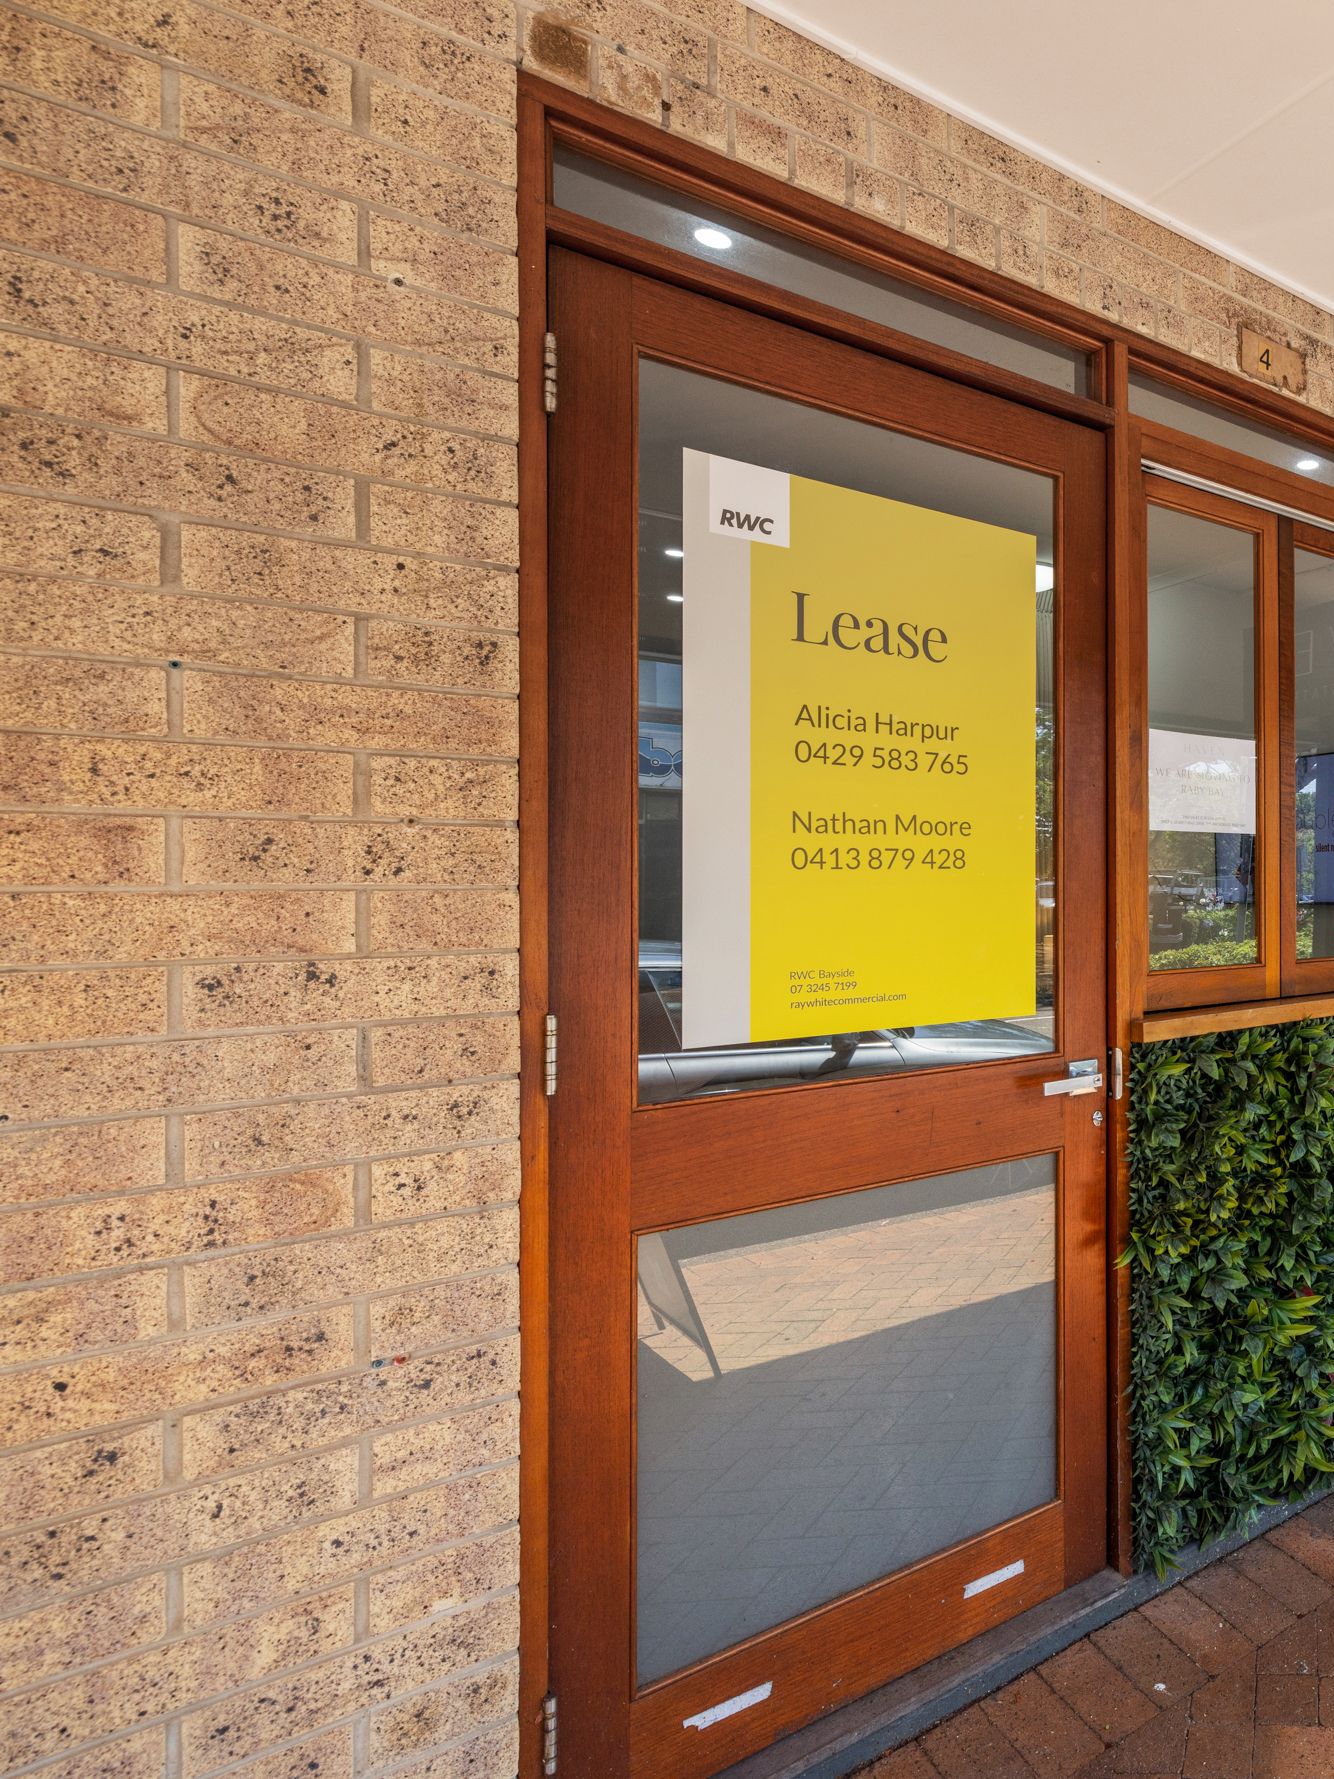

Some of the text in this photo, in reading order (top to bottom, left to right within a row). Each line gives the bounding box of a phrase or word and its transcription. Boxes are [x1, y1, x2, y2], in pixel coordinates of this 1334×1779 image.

[1259, 348, 1271, 370] 4
[719, 508, 774, 535] RWC
[791, 591, 948, 663] Lease
[794, 704, 960, 743] Alicia Harpur
[794, 740, 969, 776] 0429 583 765
[1155, 767, 1171, 777] WE
[1175, 769, 1191, 779] ARE
[791, 811, 972, 837] Nathan Moore
[791, 847, 966, 870] 0413 879 428
[789, 968, 855, 981] RWC Bayside
[790, 980, 858, 995] 07 3245 7199
[790, 991, 907, 1009] raywhitecommercial.com
